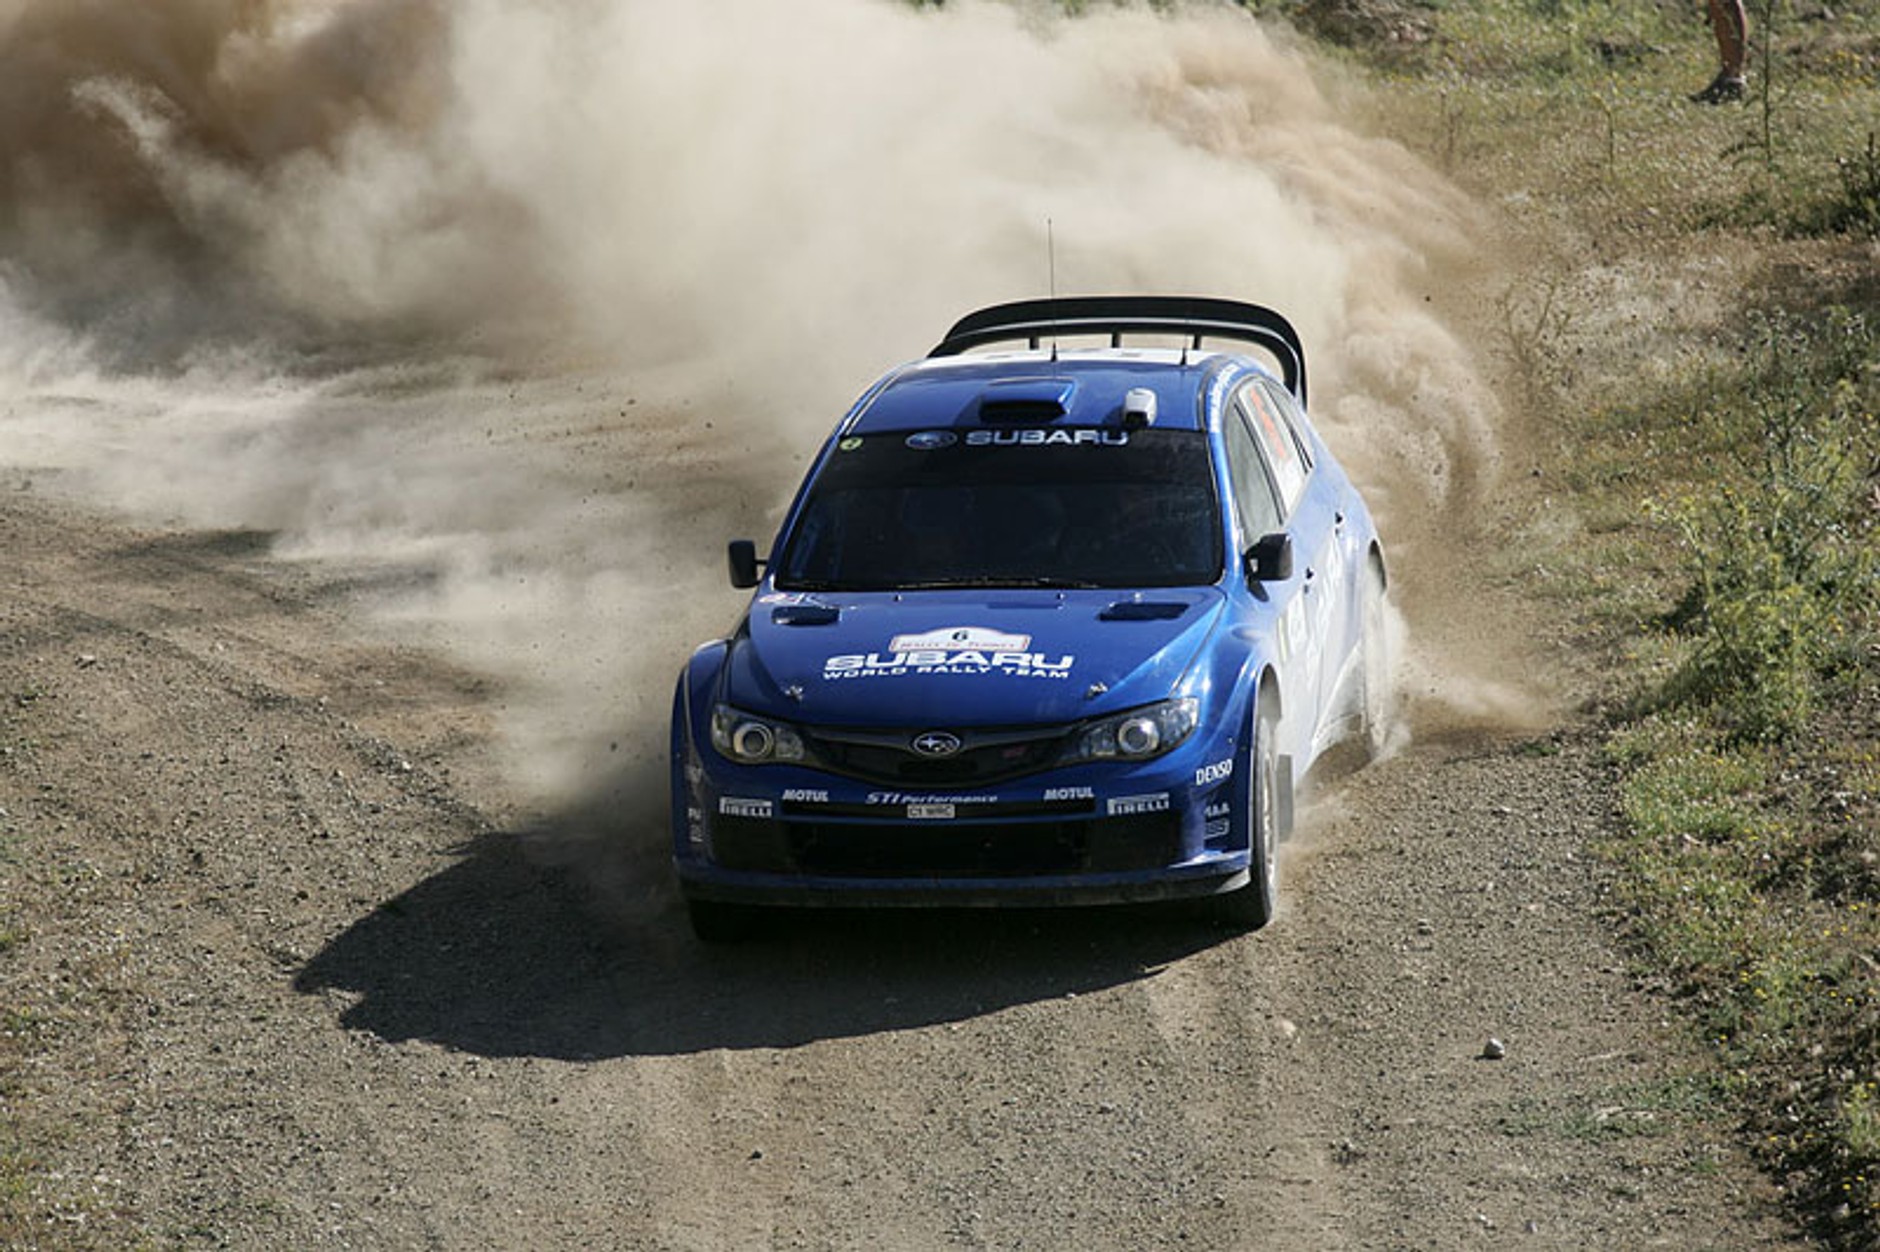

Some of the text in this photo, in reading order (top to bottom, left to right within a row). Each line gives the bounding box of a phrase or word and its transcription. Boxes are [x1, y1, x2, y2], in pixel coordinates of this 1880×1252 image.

[966, 429, 1129, 445] SUBARU
[951, 630, 968, 642] 6
[824, 650, 1075, 670] SUBARU
[823, 666, 1070, 680] WORLD RALLY TEAM
[1195, 758, 1233, 786] DENSO
[782, 788, 829, 802] MOTUL
[1043, 786, 1095, 801] MOTUL
[719, 796, 773, 817] PIRELLI
[1107, 792, 1170, 815] PIRELLI
